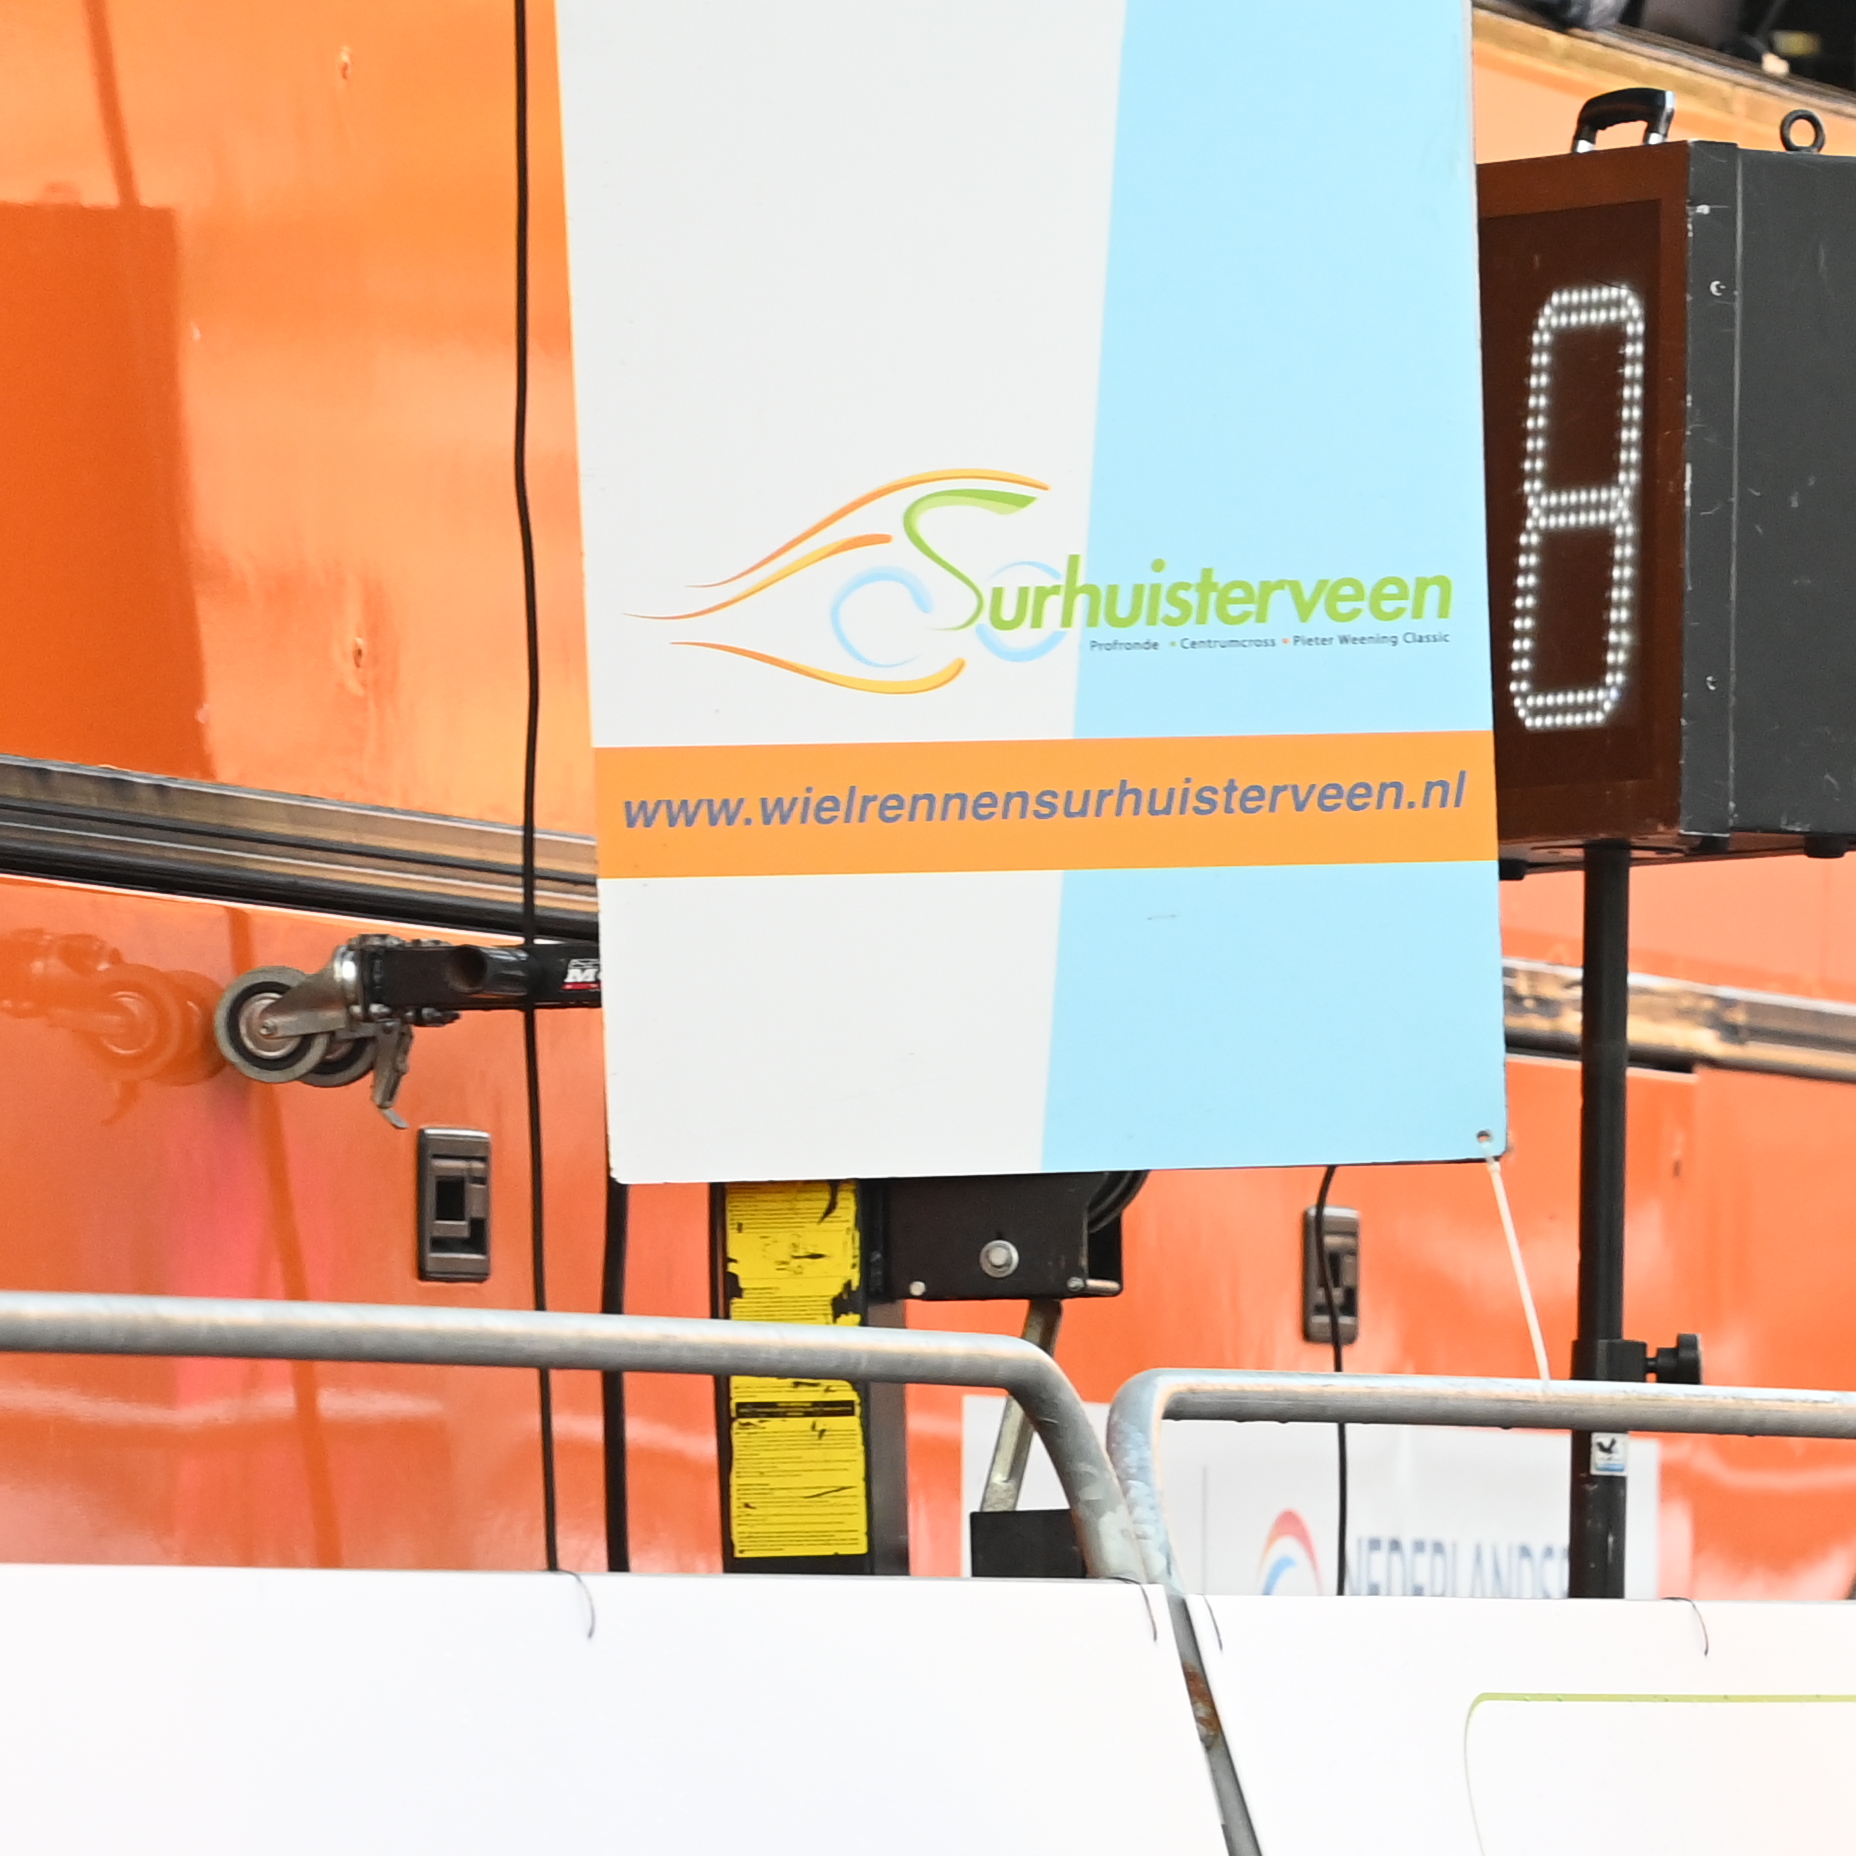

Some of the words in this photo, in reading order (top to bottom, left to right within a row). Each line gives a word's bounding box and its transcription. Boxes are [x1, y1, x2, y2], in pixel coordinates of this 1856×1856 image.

[903, 487, 1453, 632] Surhuisterveen
[1089, 638, 1160, 652] Profronde
[1179, 635, 1277, 650] Centrumcross
[1292, 633, 1335, 648] Pieter
[1337, 631, 1399, 648] Weening
[1403, 630, 1451, 644] Classic
[623, 769, 1468, 829] www.wielrennensurhuisterveen.nl
